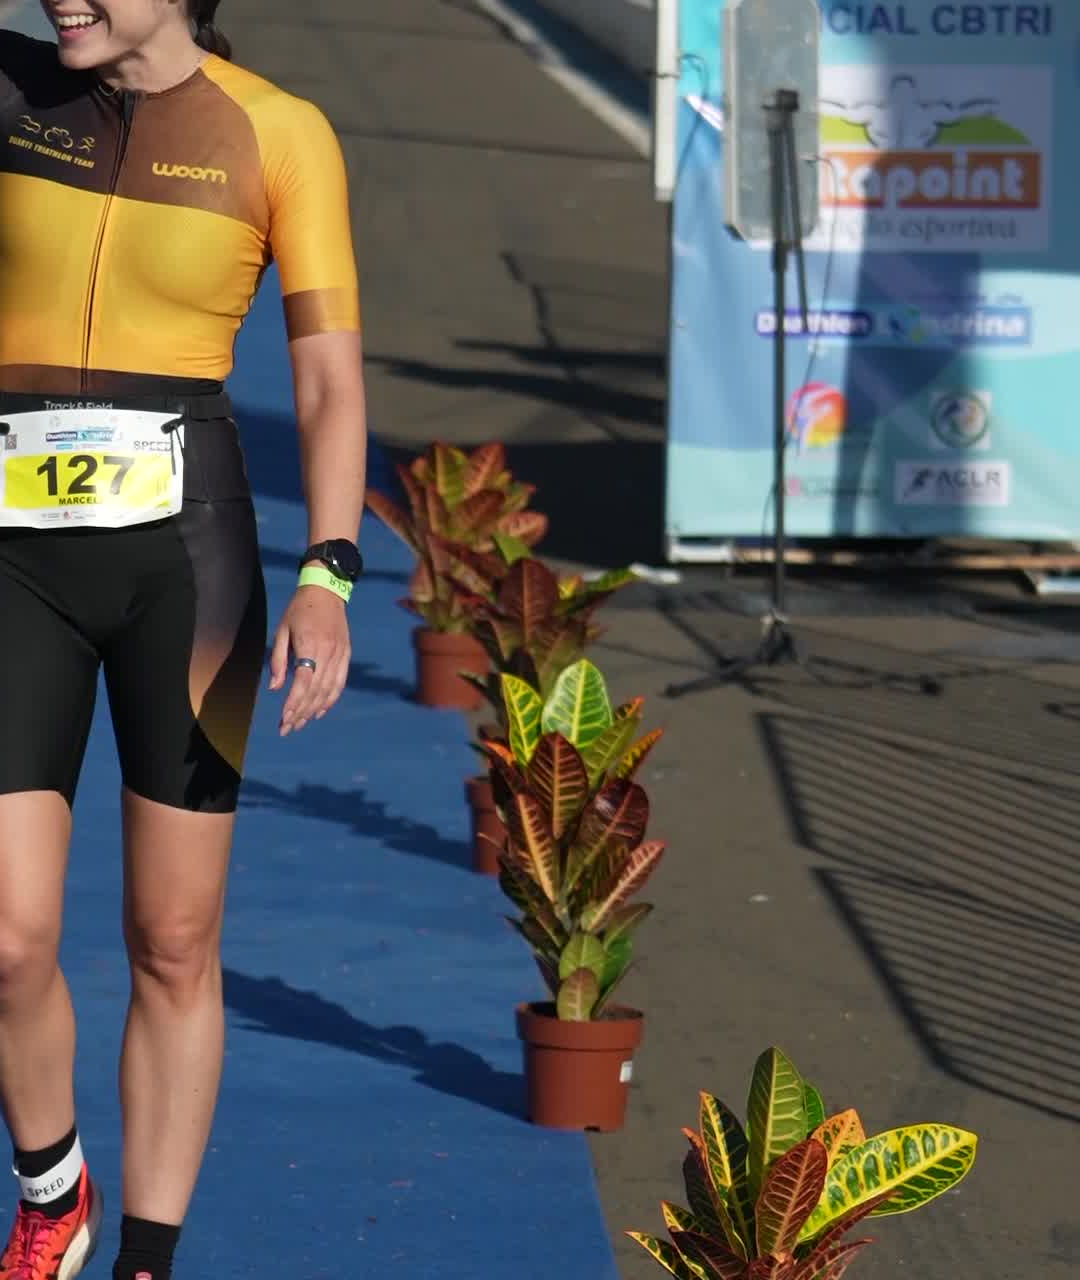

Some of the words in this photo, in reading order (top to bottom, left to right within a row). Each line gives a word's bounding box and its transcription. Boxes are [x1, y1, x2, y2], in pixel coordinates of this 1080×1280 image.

[931, 3, 1055, 36] CBTRI
[73, 156, 96, 169] TEAM
[151, 161, 228, 185] woom
[36, 454, 135, 497] 127
[936, 470, 1001, 489] ACLR
[27, 1176, 65, 1198] SPEED
